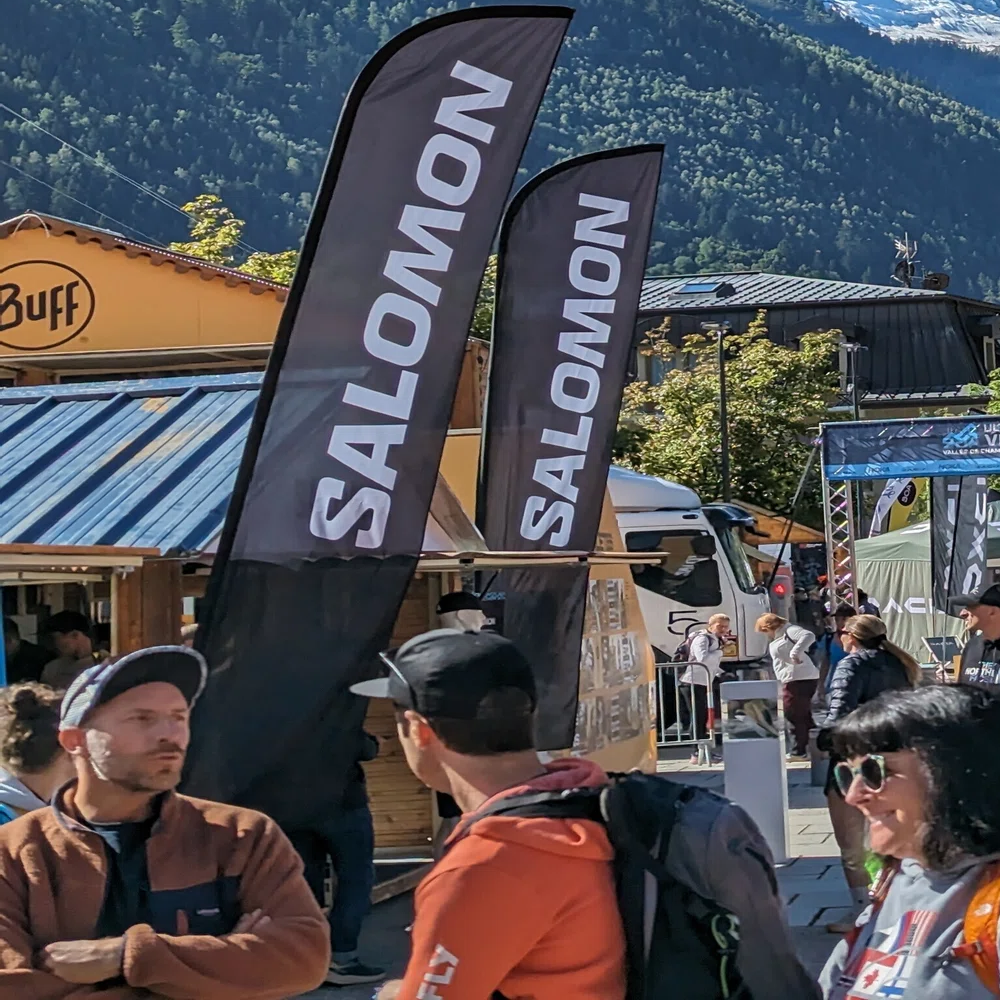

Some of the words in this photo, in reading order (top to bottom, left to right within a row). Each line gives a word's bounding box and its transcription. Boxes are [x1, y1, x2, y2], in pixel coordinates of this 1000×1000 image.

[310, 60, 514, 549] SALOMON
[520, 193, 631, 547] SALOMON
[901, 484, 912, 503] BOA
[415, 943, 460, 1000] FLY
